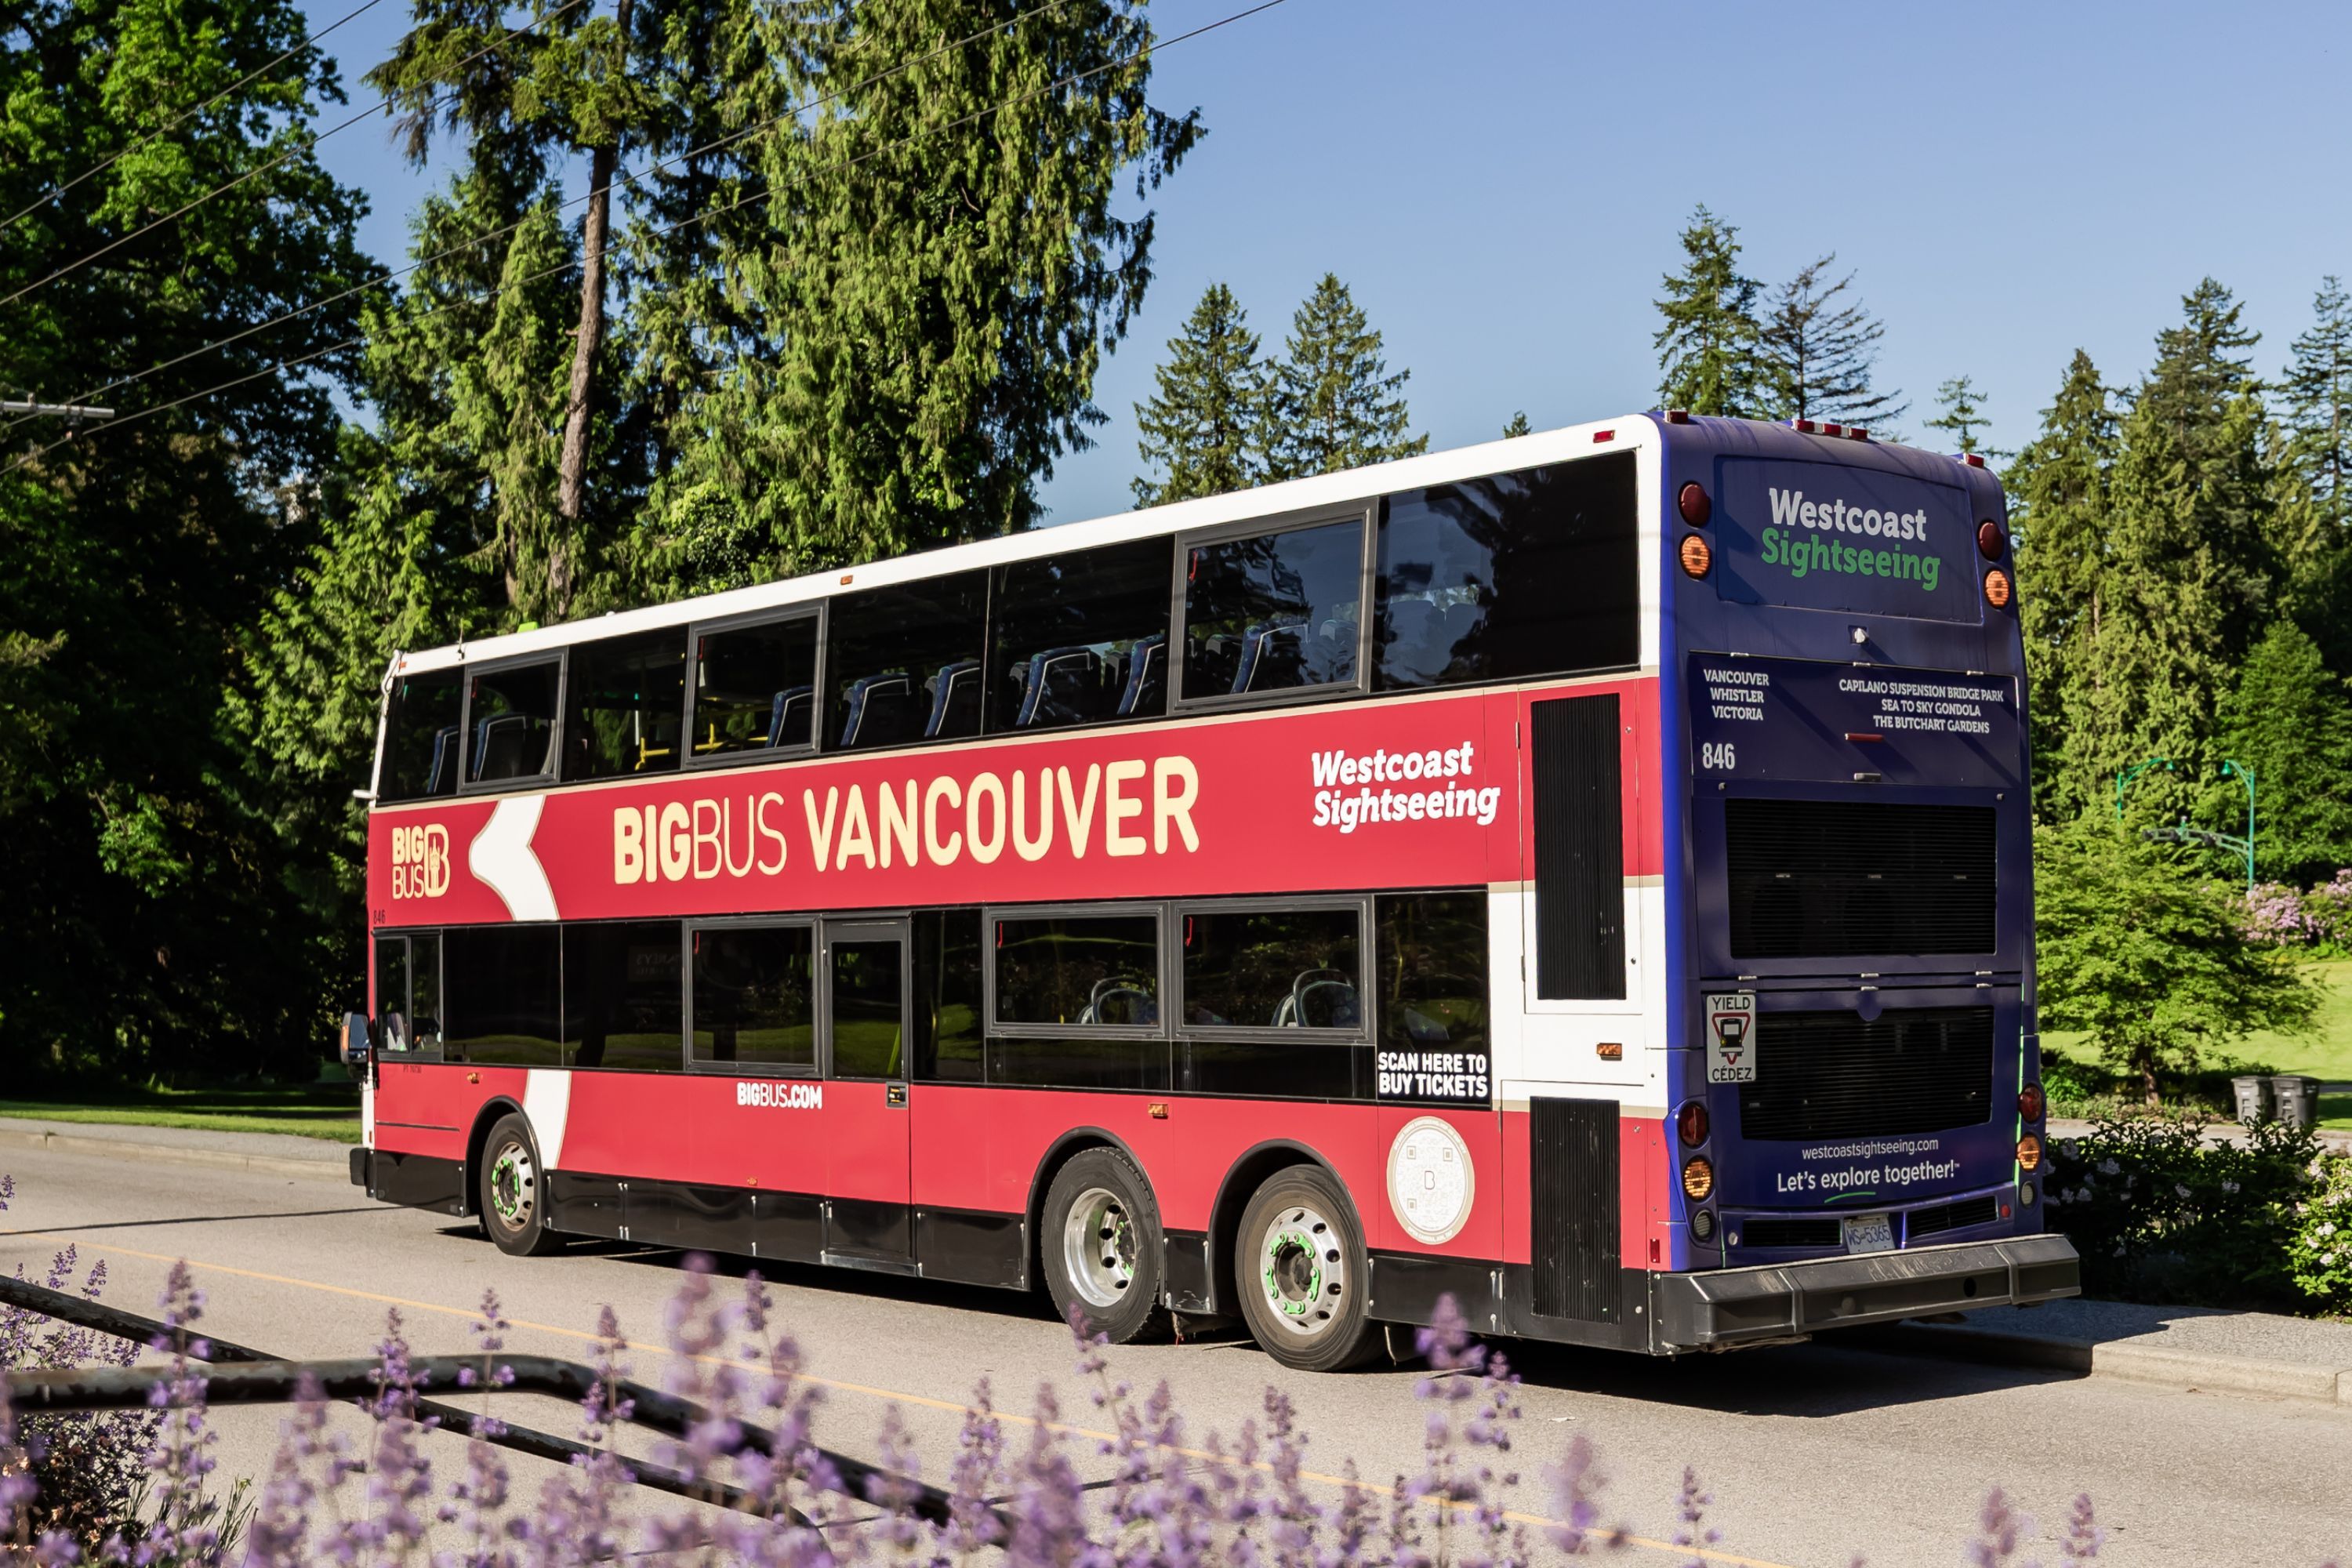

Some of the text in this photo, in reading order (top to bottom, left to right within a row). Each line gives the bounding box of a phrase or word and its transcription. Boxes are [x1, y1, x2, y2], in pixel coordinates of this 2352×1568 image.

[1769, 488, 1927, 541] Westcoast
[1761, 528, 1940, 591] Sightseeing
[1704, 669, 1769, 687] VANCOUVER
[1710, 688, 1764, 703] WHISTLER
[1839, 679, 2004, 702] CAPILANO SUSPENSION BRIDGE PARK
[1712, 705, 1763, 720] VICTORIA
[1882, 699, 1981, 717] SEA TO SKY GONDOLA
[1873, 715, 1990, 733] THE BUTCHART GARDENS
[1312, 741, 1474, 787] Westcoast
[1702, 742, 1735, 769] 846
[1312, 781, 1501, 833] Sightseeing
[614, 756, 1200, 884] BIGBUS VANCOUVER
[393, 826, 423, 864] BIG
[393, 865, 424, 899] BUS
[373, 909, 386, 924] 846
[1712, 997, 1751, 1010] YIELD
[1377, 1051, 1486, 1073] SCAN HERE TO
[1712, 1065, 1752, 1081] CÉDEZ
[737, 1082, 822, 1109] BIGBUS.COM
[1379, 1072, 1488, 1098] BUY TICKETS
[1802, 1138, 1939, 1160] westcoastsightseeing.com
[1777, 1171, 1816, 1192] Let's
[1821, 1167, 1880, 1191] explore
